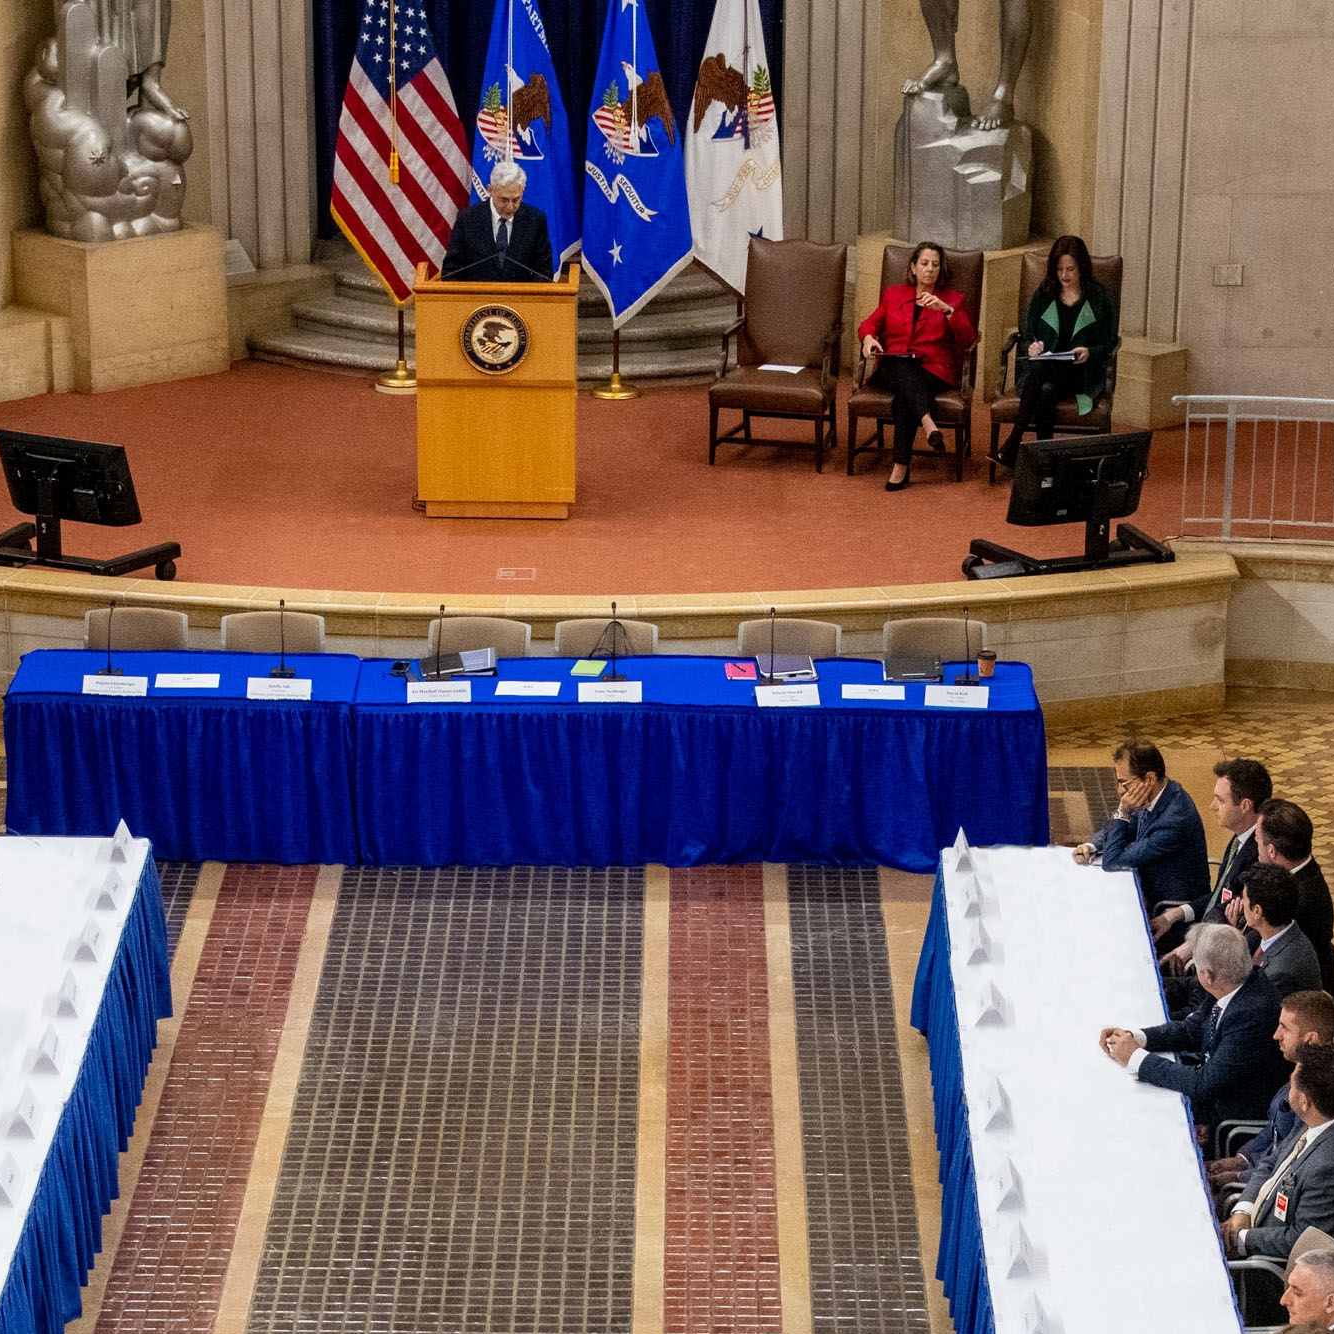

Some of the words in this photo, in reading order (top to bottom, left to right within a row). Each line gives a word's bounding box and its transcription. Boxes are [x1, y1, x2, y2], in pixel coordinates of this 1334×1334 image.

[587, 165, 613, 200] JUSTITIA
[618, 177, 646, 215] SEQUITUR
[464, 309, 493, 352] DEPARTMENT
[507, 313, 527, 347] JUSTICE
